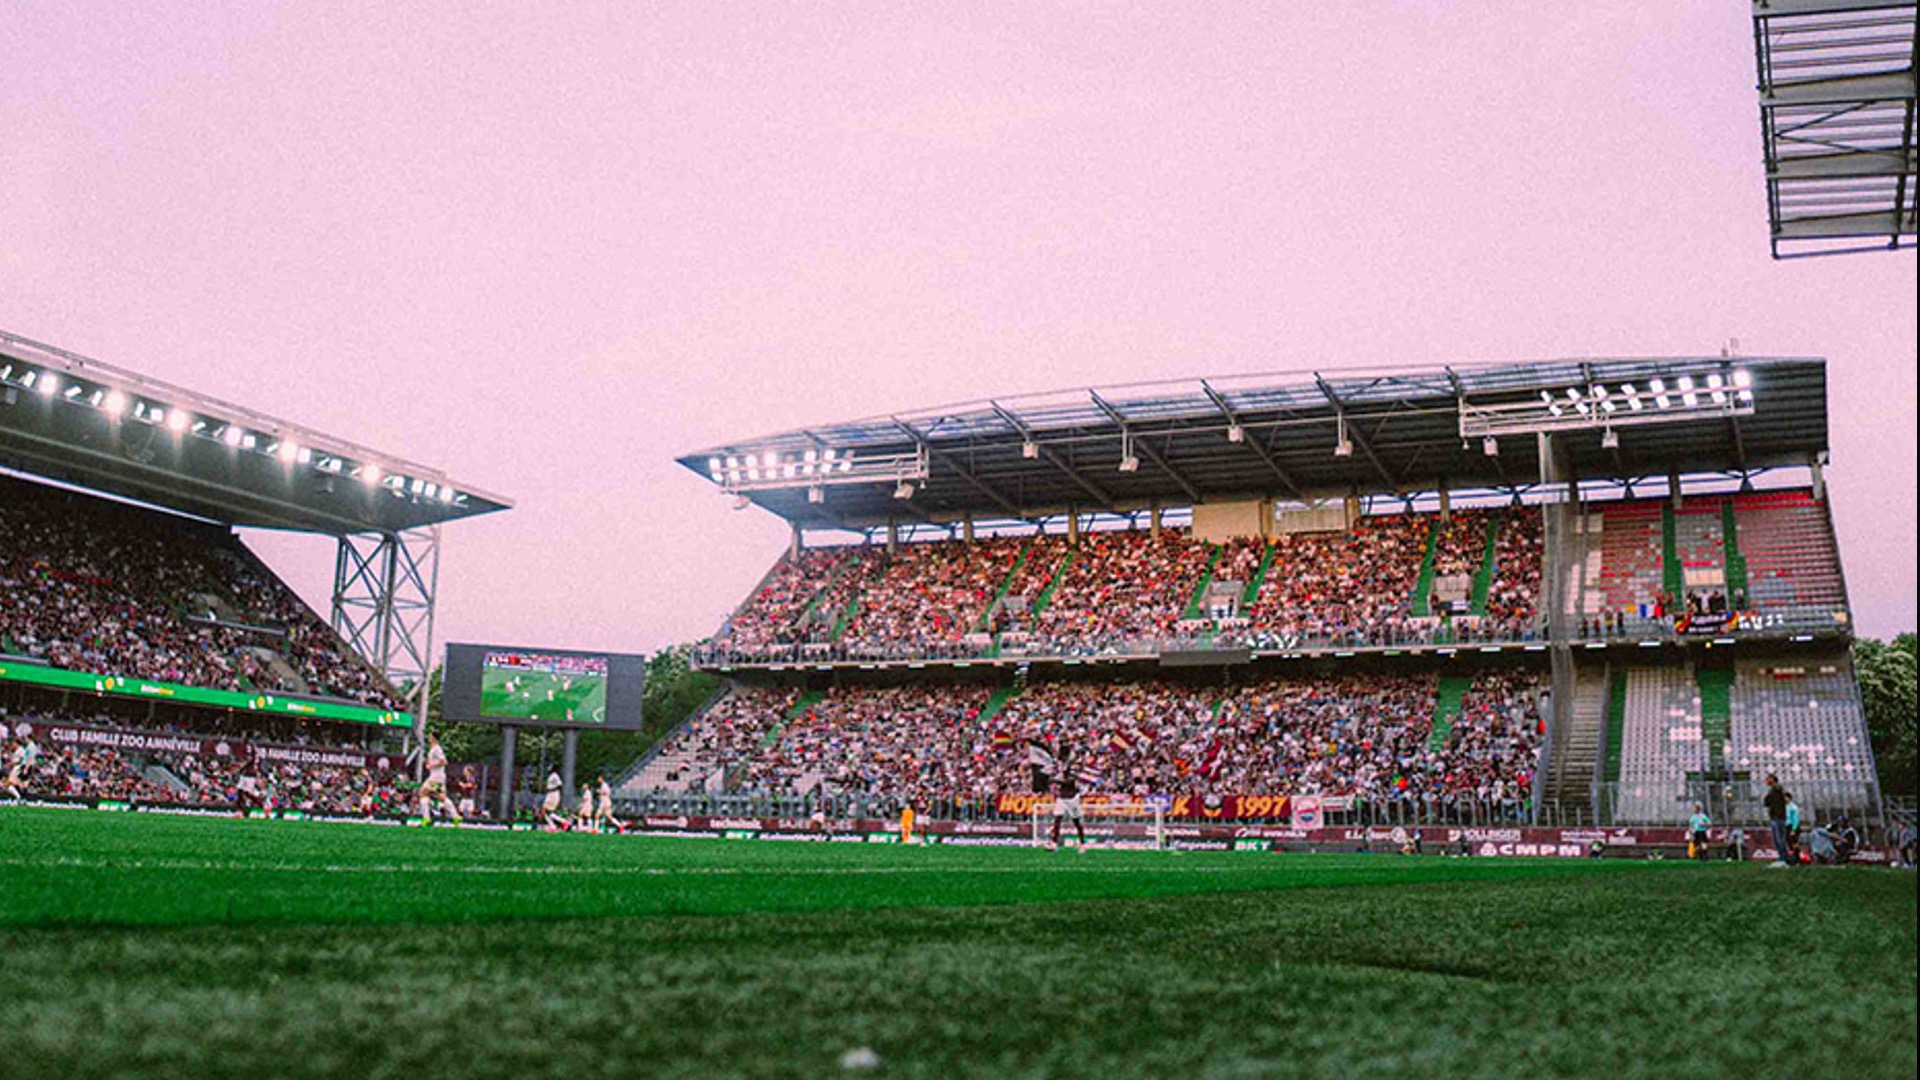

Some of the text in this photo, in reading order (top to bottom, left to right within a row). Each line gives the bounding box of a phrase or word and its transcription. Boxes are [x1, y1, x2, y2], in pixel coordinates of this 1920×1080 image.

[51, 728, 201, 753] CLUB FAMILLE ZOO AMNÉVILLE
[268, 748, 299, 761] FAMILLE
[299, 751, 320, 763] ZOO
[321, 752, 366, 767] AMNÉVILLE
[1235, 796, 1287, 816] 1997
[1235, 840, 1271, 851] BKT
[1499, 843, 1580, 857] CMPM
